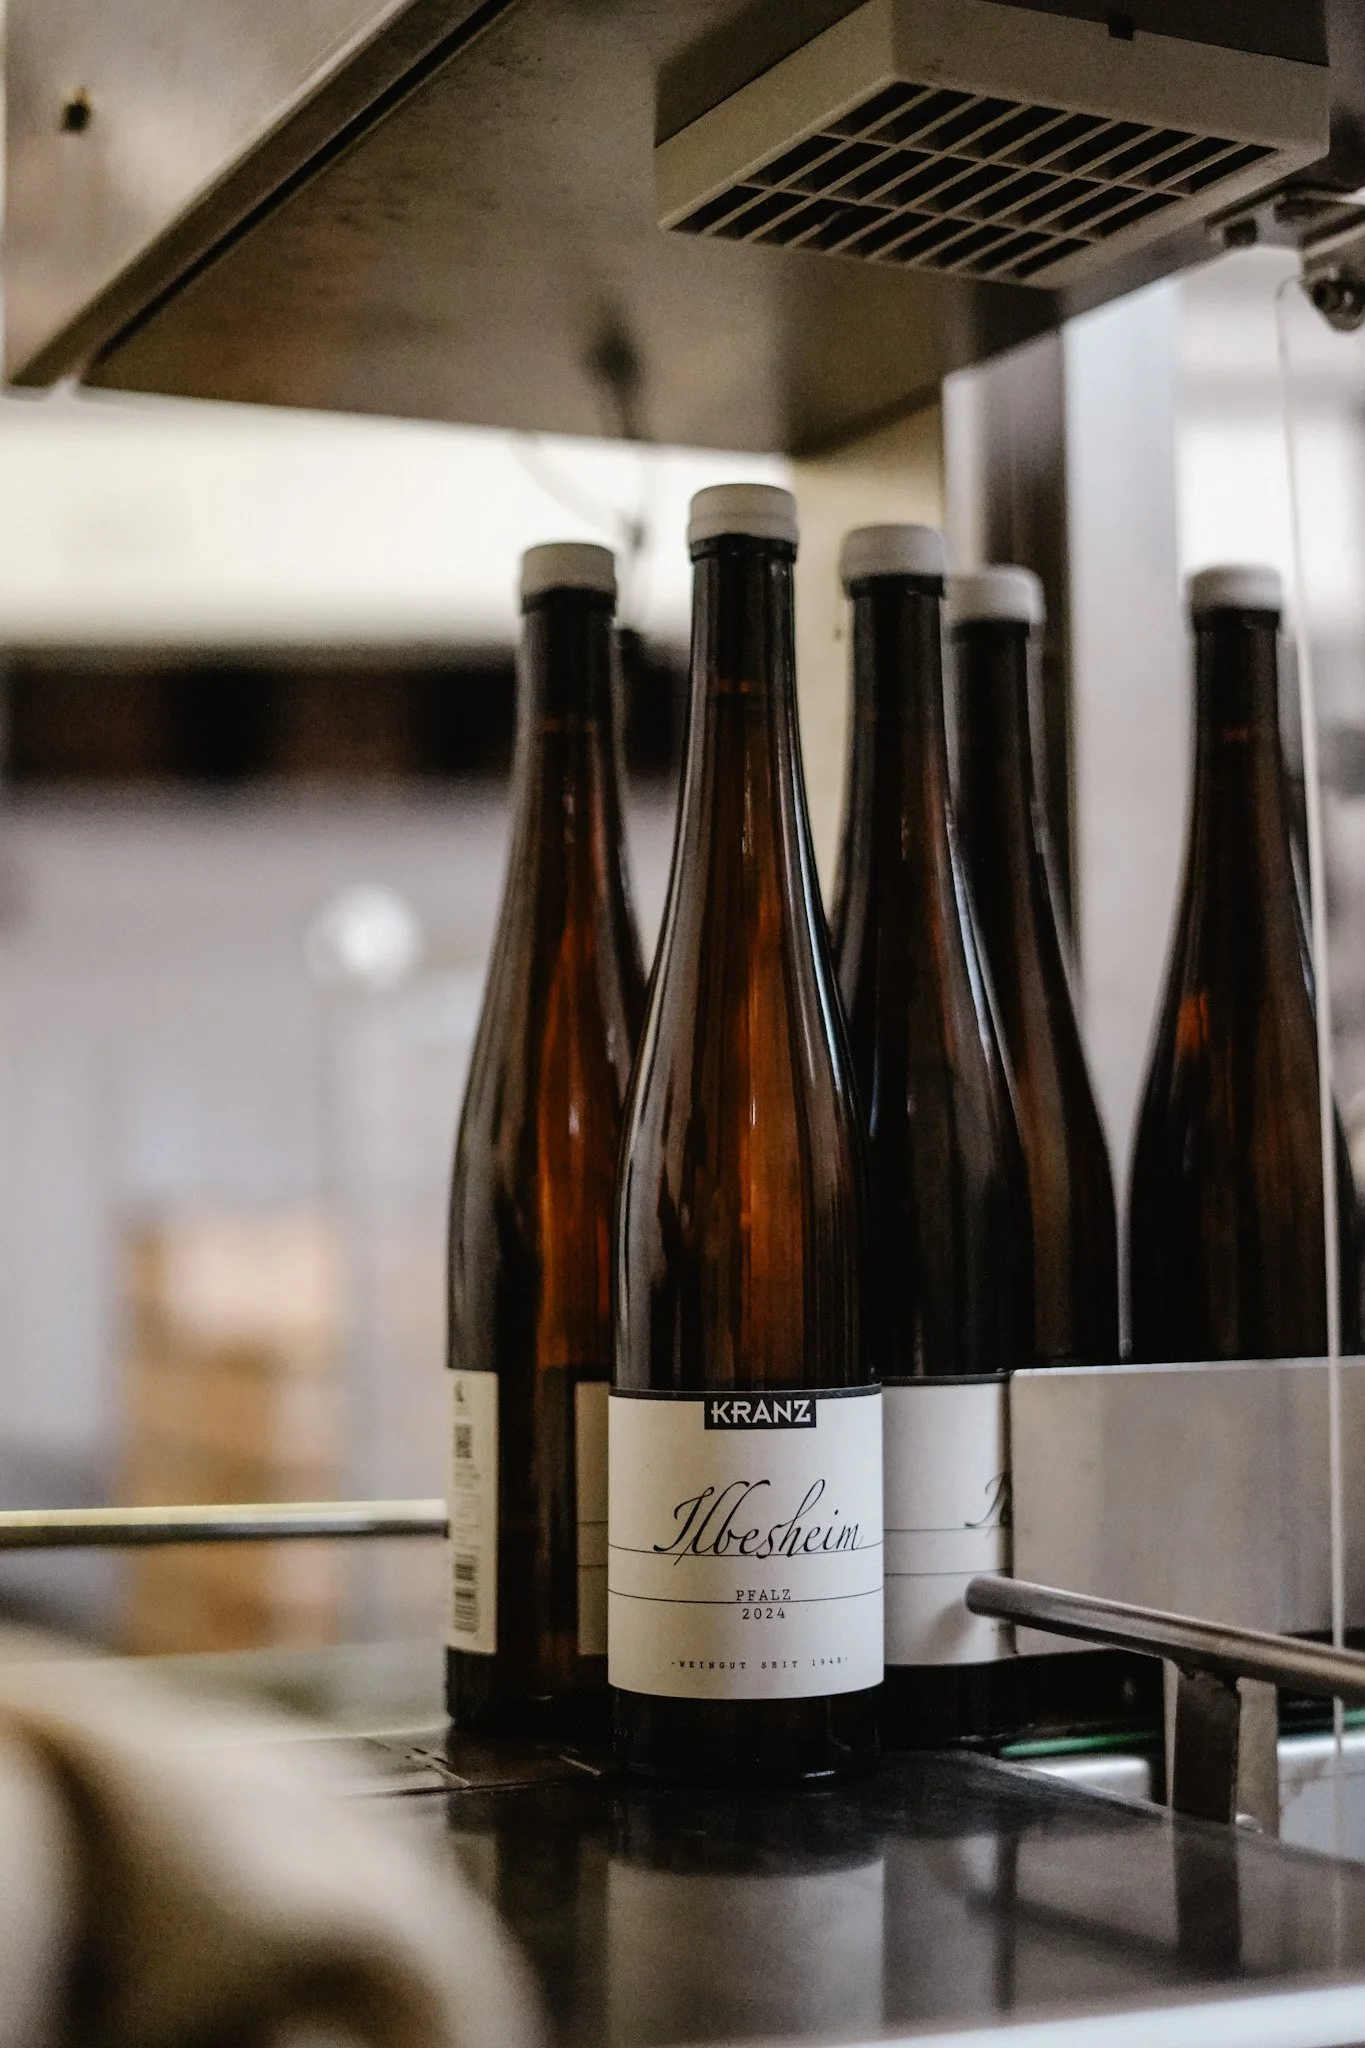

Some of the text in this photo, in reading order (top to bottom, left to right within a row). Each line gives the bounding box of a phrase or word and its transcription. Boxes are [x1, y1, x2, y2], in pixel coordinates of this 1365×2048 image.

[710, 1399, 811, 1424] KRANZ
[653, 1478, 866, 1566] Ilbesheim
[735, 1589, 792, 1601] PFALZ
[742, 1607, 786, 1620] 2024
[761, 1660, 798, 1669] SEIT
